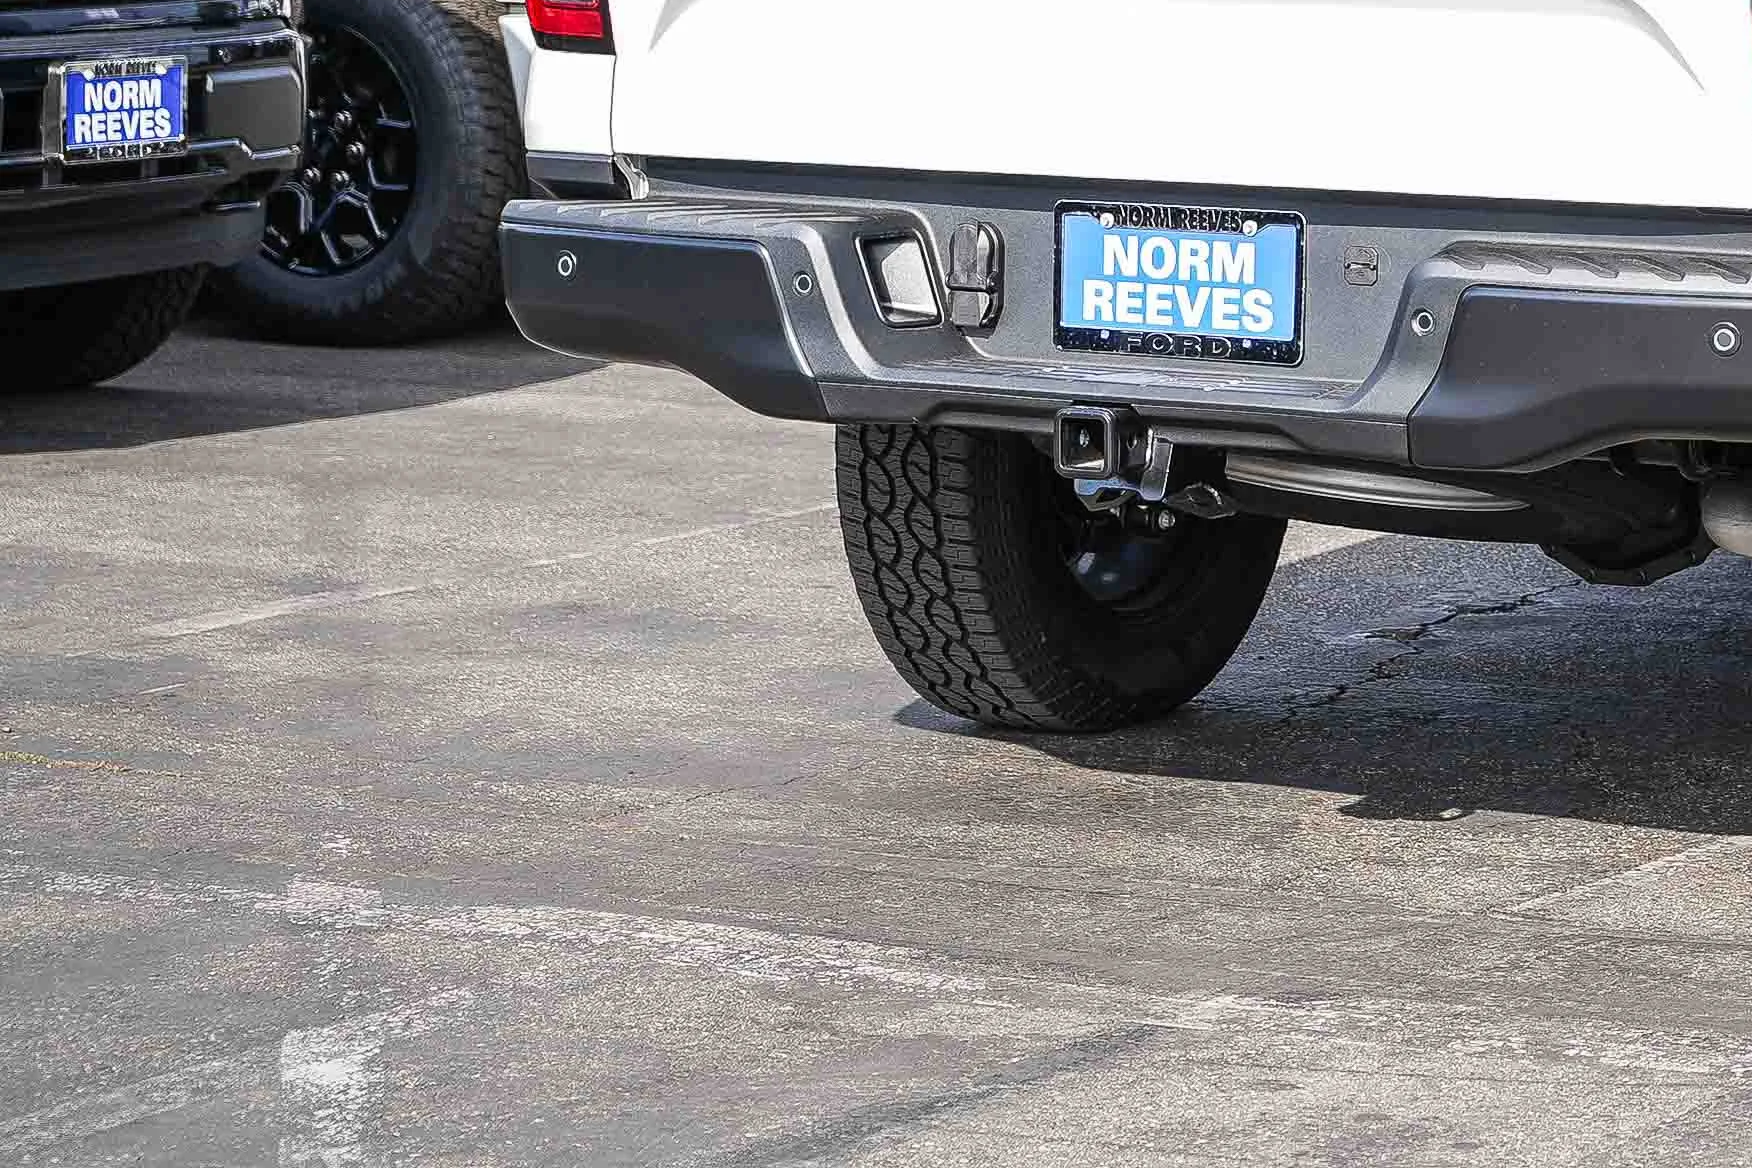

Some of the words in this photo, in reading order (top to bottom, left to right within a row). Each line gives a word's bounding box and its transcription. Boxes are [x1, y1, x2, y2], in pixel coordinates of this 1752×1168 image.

[84, 78, 162, 112] NORM
[74, 107, 172, 143] REEVES
[1115, 203, 1173, 229] NORM
[1178, 207, 1243, 233] REEVES
[1102, 234, 1256, 285] NORM
[1082, 279, 1274, 333] REEVES
[1124, 330, 1232, 358] FORD
